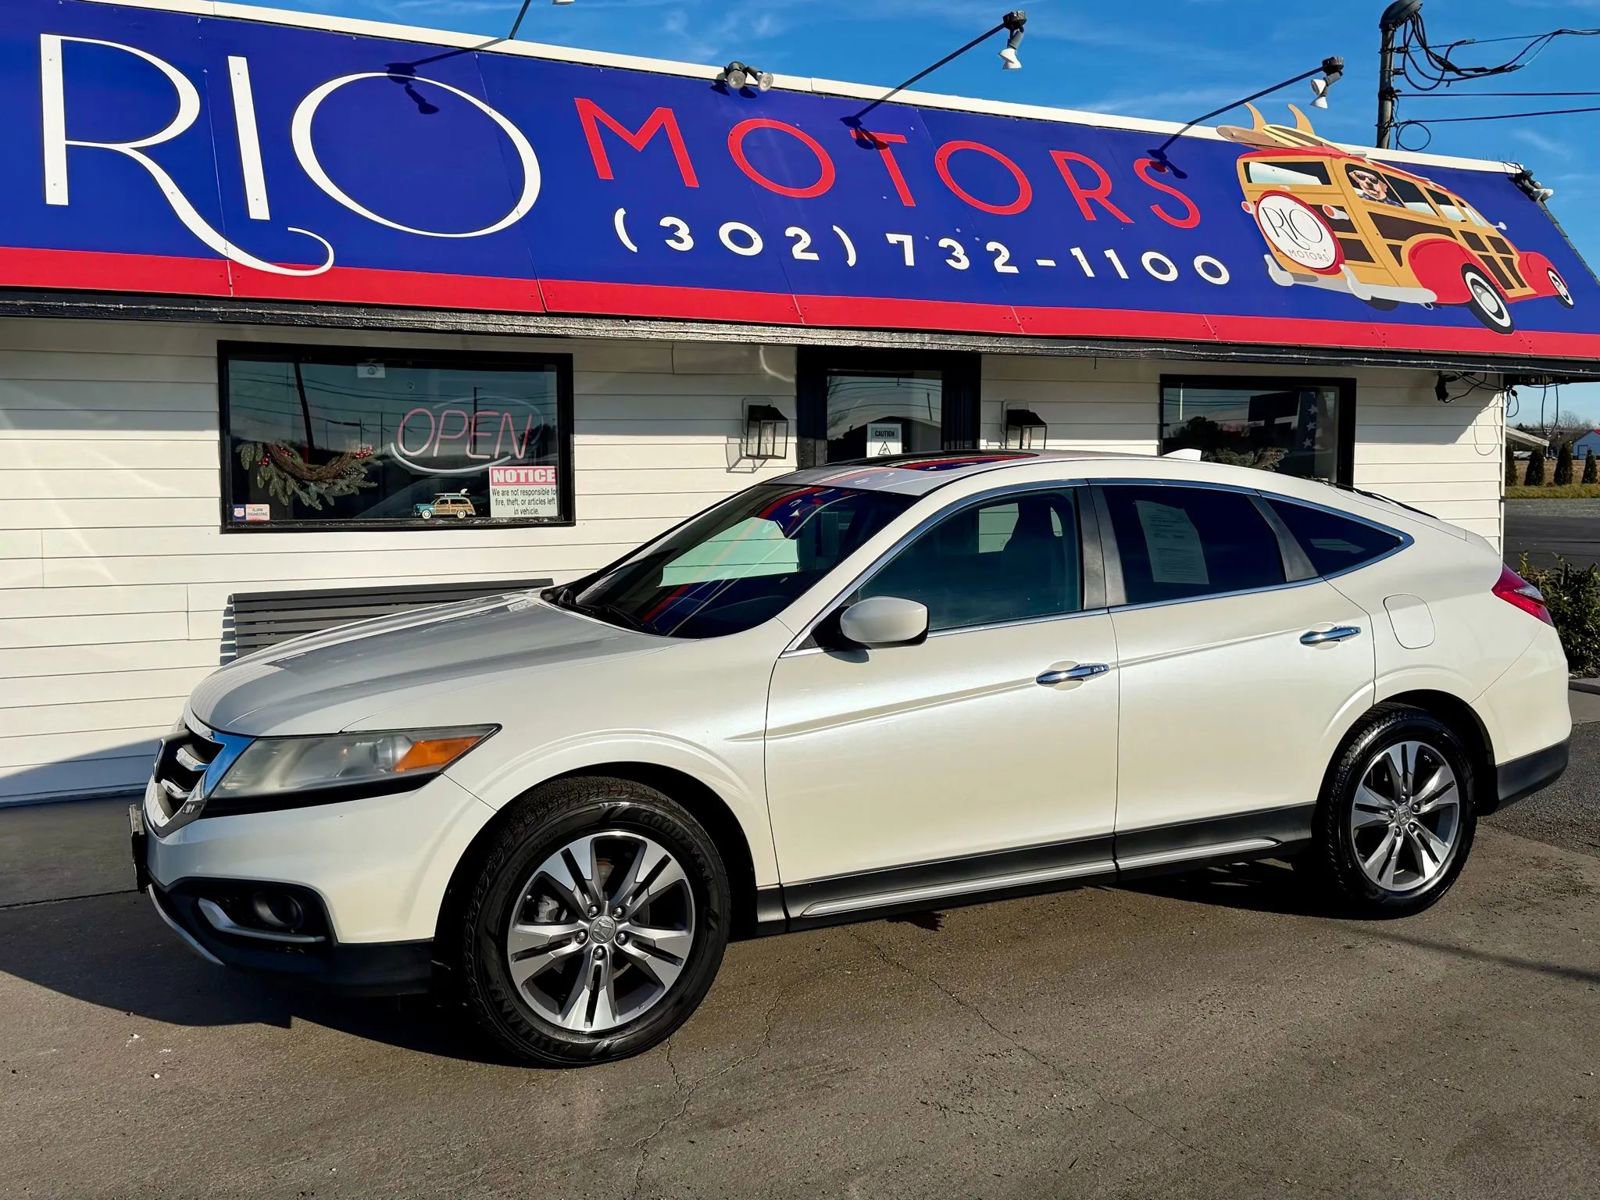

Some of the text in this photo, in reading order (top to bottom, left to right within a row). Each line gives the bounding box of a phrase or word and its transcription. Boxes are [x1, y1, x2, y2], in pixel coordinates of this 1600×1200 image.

[40, 33, 1200, 277] RIO MOTORS
[1261, 206, 1323, 250] RIO
[613, 207, 1231, 286] (302) 732-1100
[1287, 248, 1331, 262] MOTORS
[397, 407, 532, 460] OPEN
[492, 469, 556, 483] NOTICE
[492, 488, 500, 497] We
[511, 488, 519, 496] not
[520, 488, 550, 497] responsible
[528, 497, 546, 506] articles
[547, 497, 556, 505] left
[514, 507, 519, 515] in
